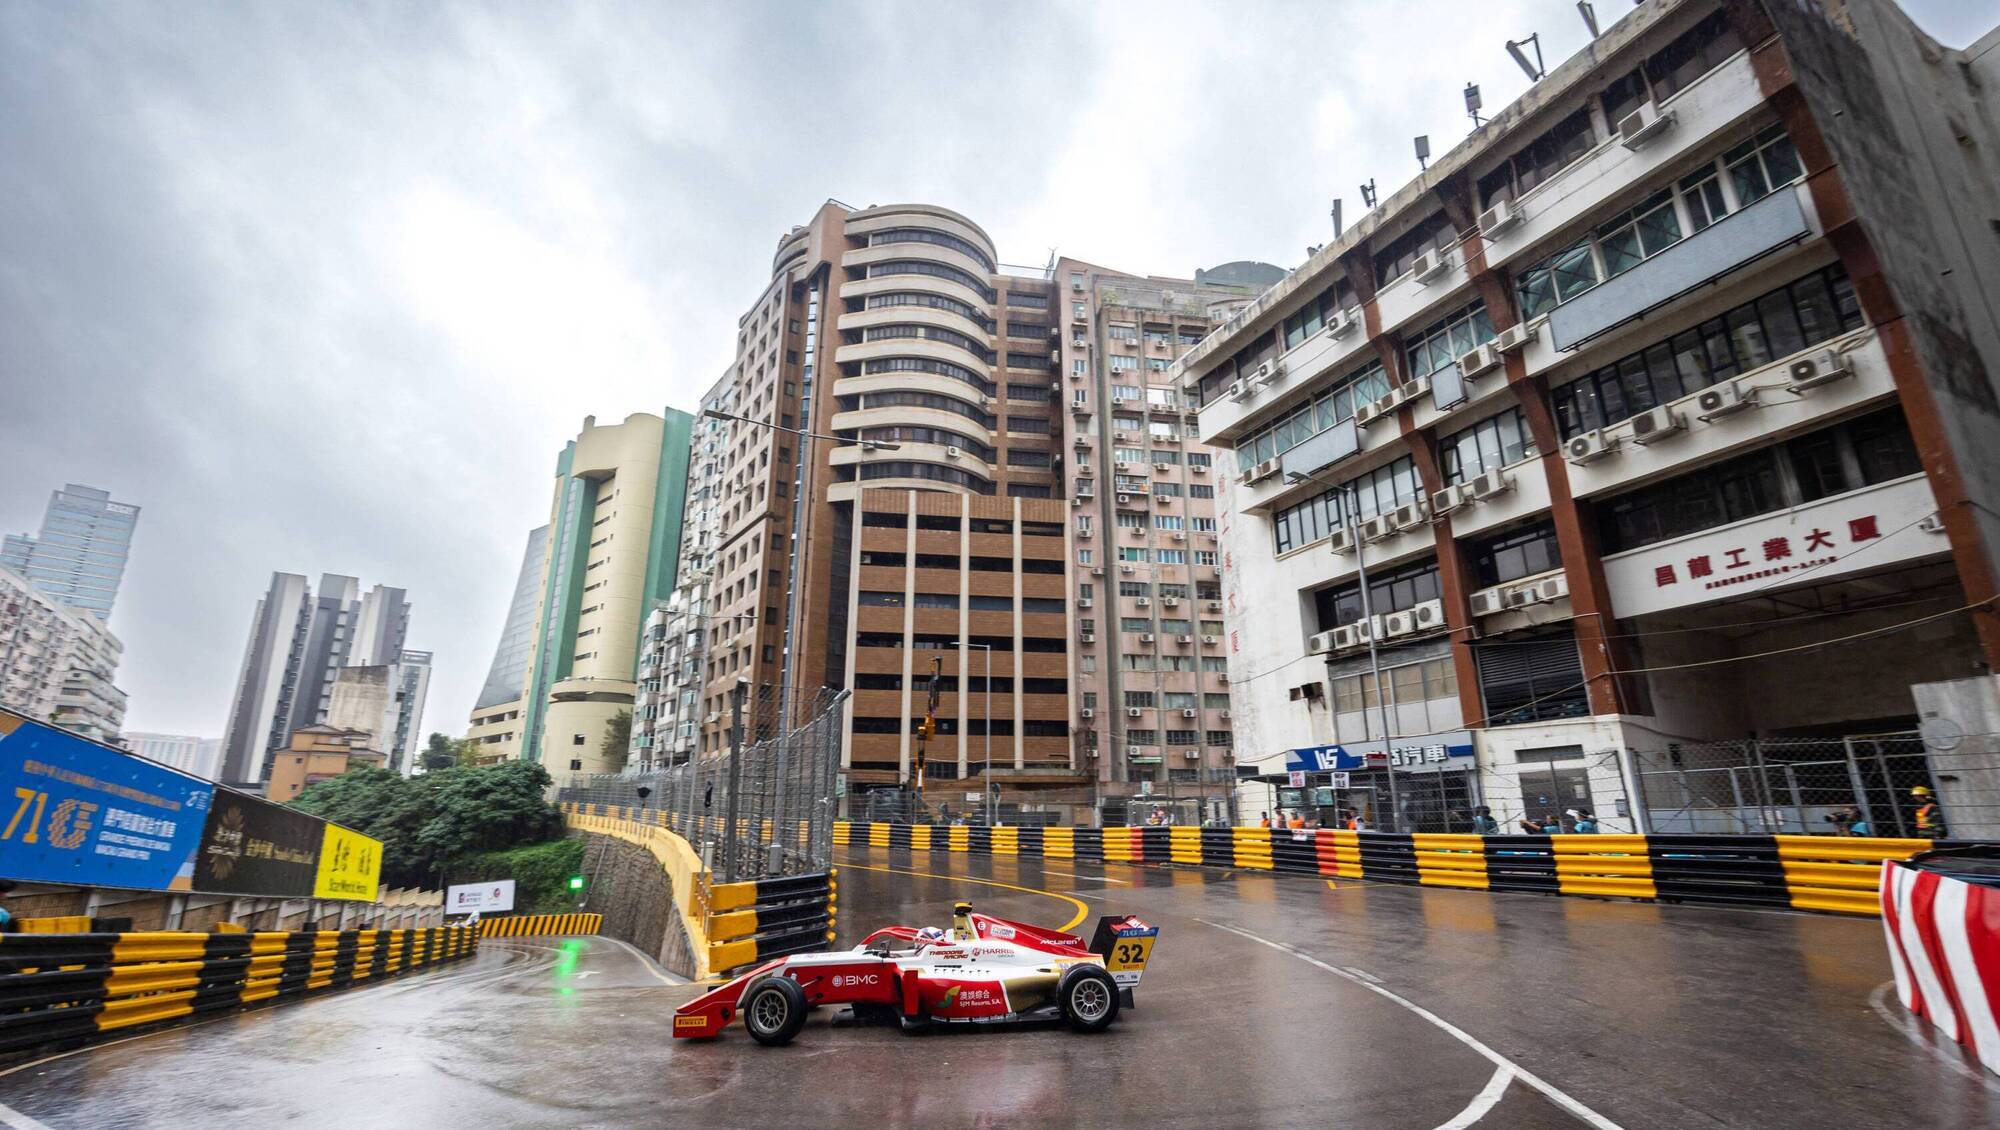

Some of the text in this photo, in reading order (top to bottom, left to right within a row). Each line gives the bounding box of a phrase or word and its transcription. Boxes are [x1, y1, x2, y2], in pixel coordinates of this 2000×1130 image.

[1, 787, 48, 844] 71
[1040, 937, 1079, 945] McLaren
[1118, 943, 1145, 964] 32
[845, 974, 879, 986] BMC
[959, 1000, 971, 1008] SJM
